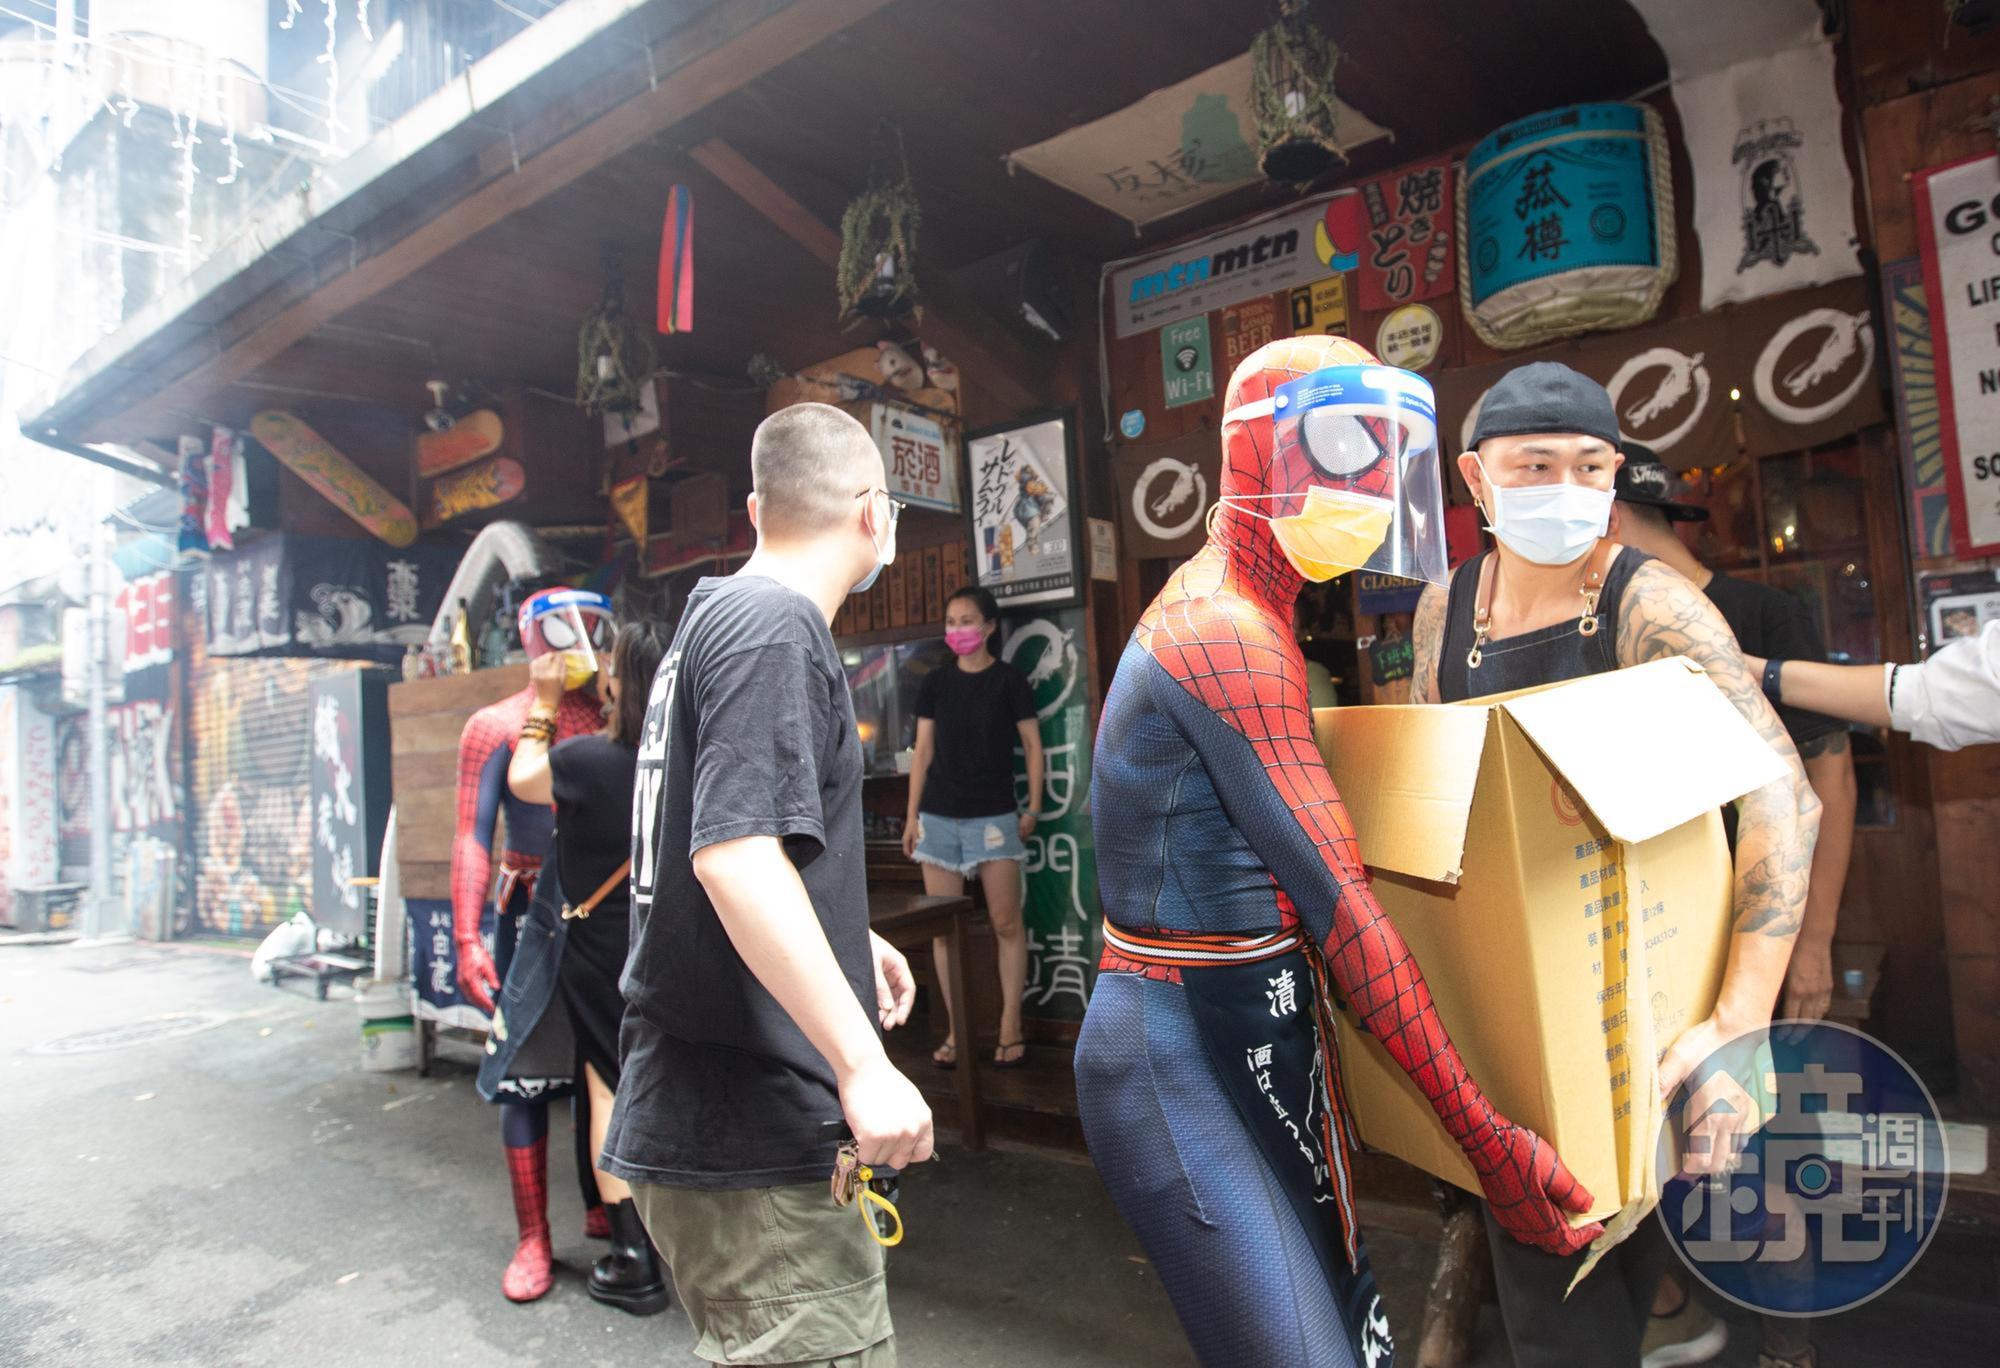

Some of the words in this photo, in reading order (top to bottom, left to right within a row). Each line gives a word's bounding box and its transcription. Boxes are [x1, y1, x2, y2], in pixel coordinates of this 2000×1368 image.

[1171, 326, 1200, 345] Free
[1226, 324, 1273, 357] BEER
[1167, 371, 1212, 399] Wi-Fi
[892, 436, 940, 483] 菸酒
[974, 457, 998, 527] サムライ
[1265, 969, 1297, 1017] 清
[1597, 978, 1627, 1005] 保存年
